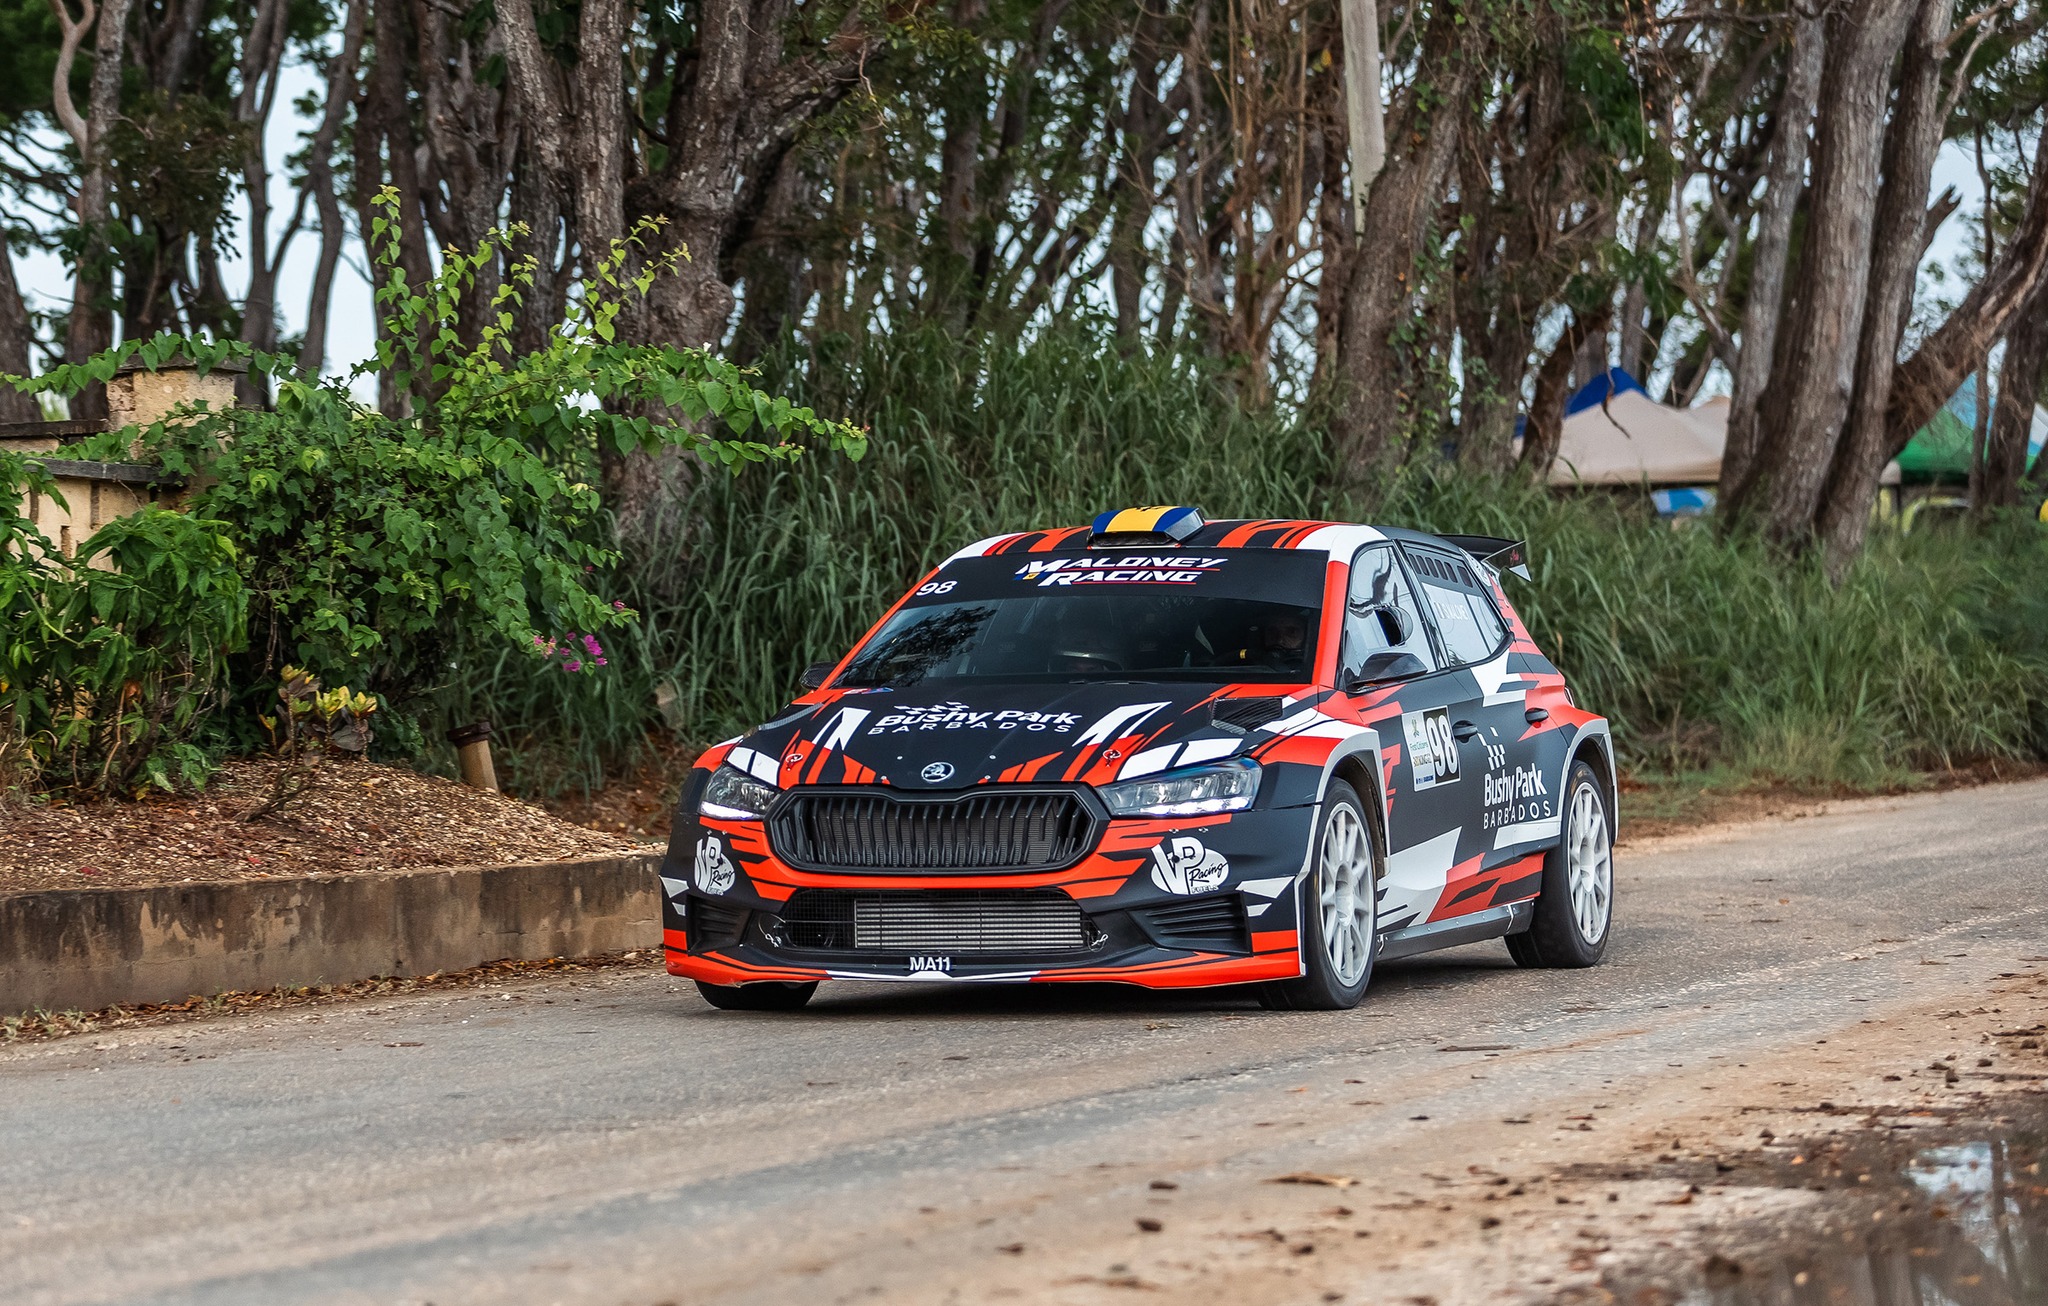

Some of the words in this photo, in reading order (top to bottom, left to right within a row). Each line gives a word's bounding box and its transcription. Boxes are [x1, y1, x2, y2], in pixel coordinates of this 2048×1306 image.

[1015, 557, 1228, 573] MALONEY
[1038, 571, 1202, 587] RACING
[916, 581, 957, 596] 98
[874, 710, 993, 726] Bushy
[993, 710, 1082, 724] Park
[867, 721, 1072, 735] BARBADOS
[1426, 715, 1458, 777] 98
[1484, 769, 1515, 812] Bushy
[1515, 763, 1547, 799] Park
[1483, 800, 1551, 829] BARBADOS
[1151, 837, 1205, 895] VP
[1189, 861, 1228, 887] Racing
[710, 870, 735, 887] Racing
[910, 957, 950, 970] MA11
